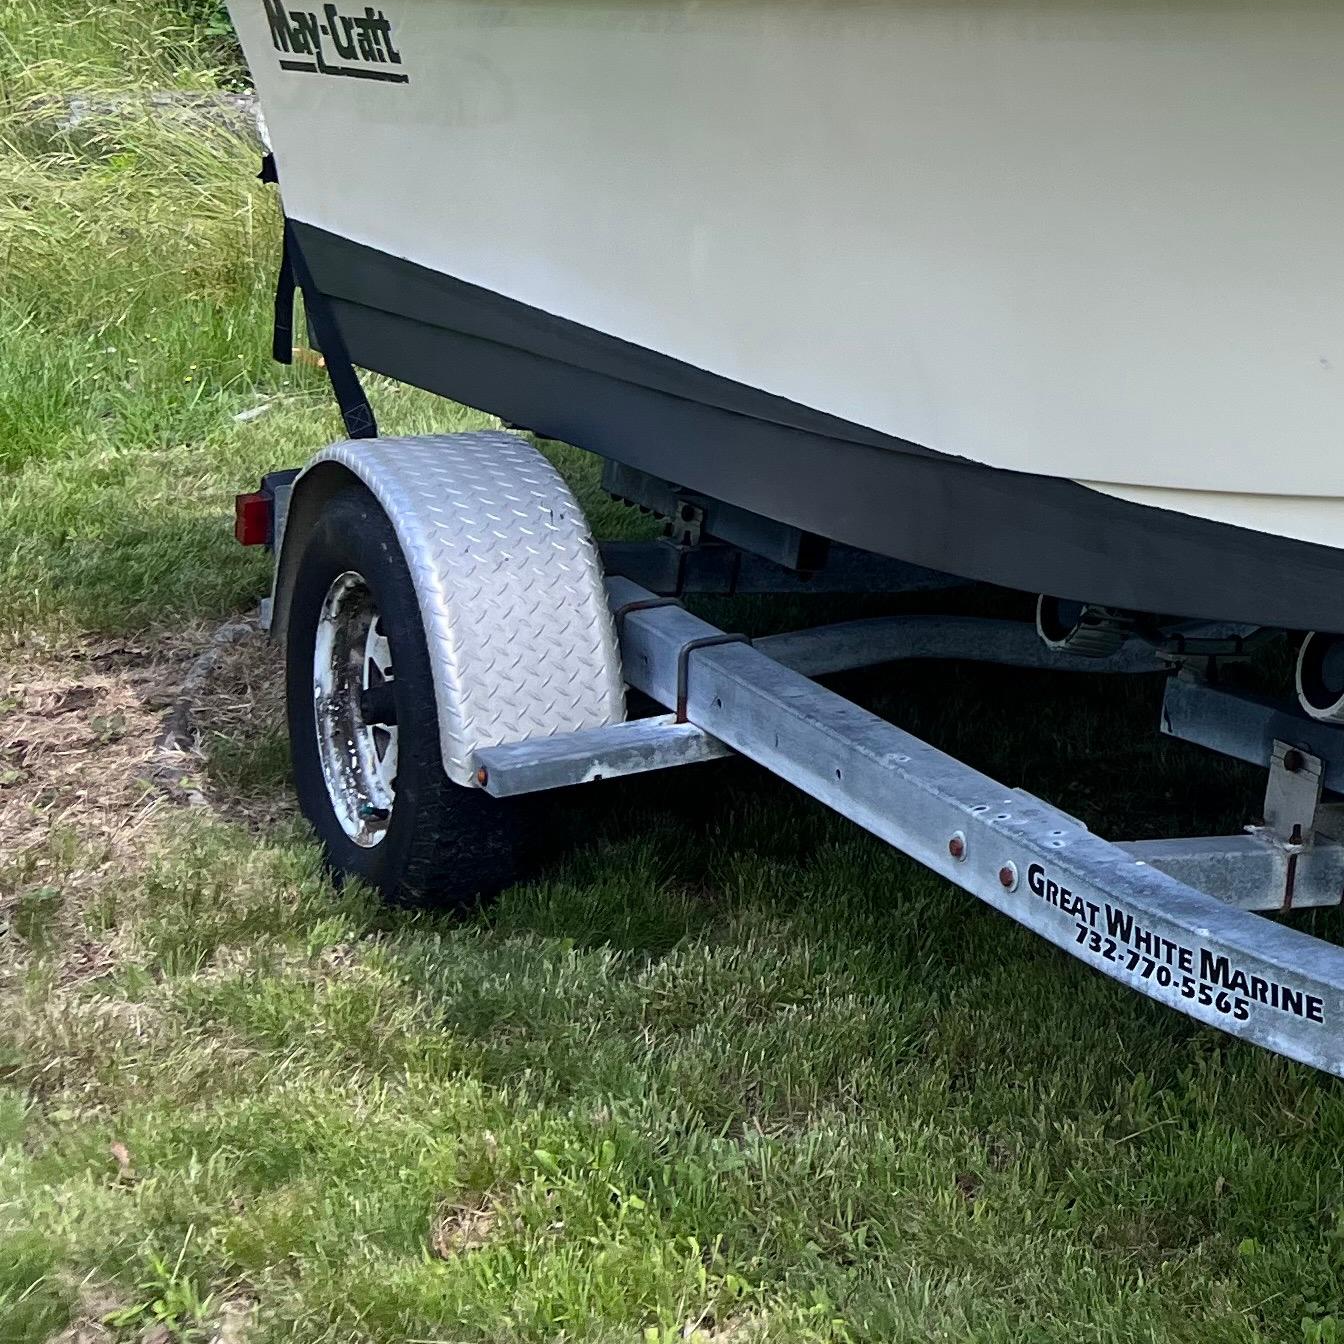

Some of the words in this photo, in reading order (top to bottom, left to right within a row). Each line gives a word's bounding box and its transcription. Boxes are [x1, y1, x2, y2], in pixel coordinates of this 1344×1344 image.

[1028, 863, 1100, 927] GREAT
[1104, 903, 1193, 975] WHITE
[1200, 947, 1324, 1024] MARINE
[1075, 922, 1250, 1021] 732-770-5565
